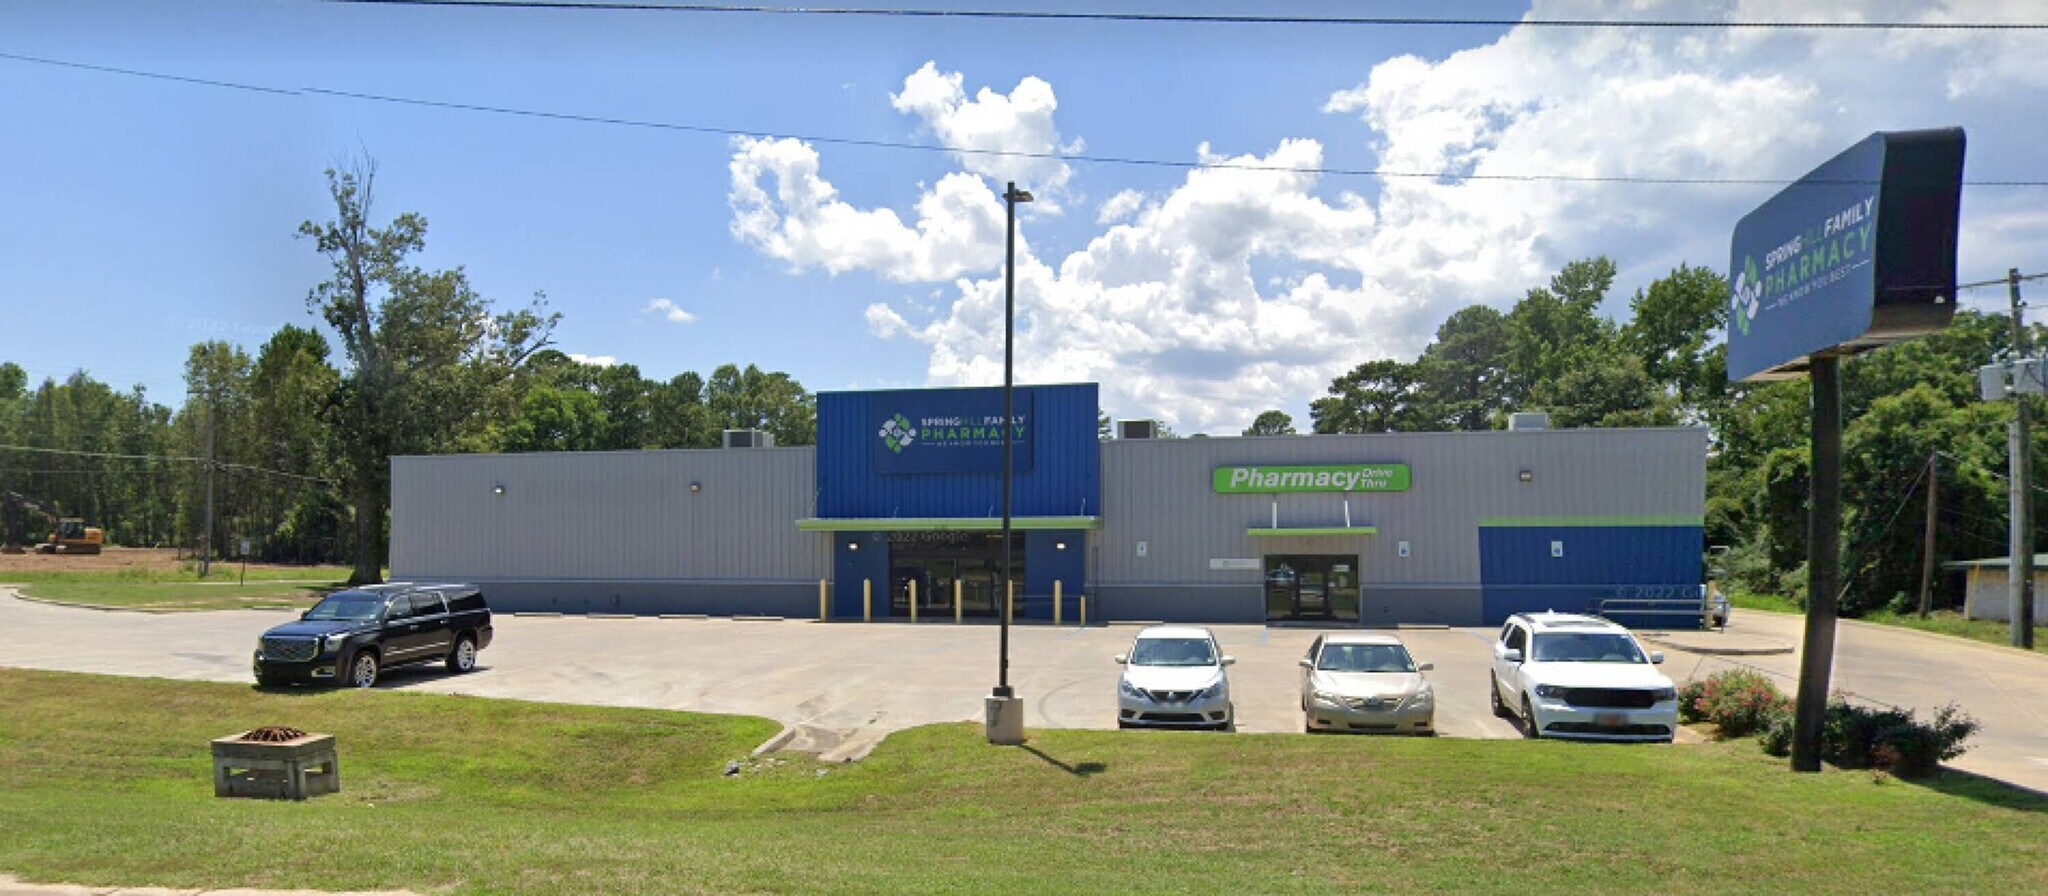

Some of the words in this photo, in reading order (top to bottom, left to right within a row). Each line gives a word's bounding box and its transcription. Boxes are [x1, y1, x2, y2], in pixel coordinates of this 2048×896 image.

[1765, 223, 1873, 299] PHARMACY
[921, 426, 1026, 441] PHARMAY
[1230, 467, 1360, 491] Pharmacy
[1361, 467, 1393, 478] Drive
[1361, 478, 1387, 488] Thru
